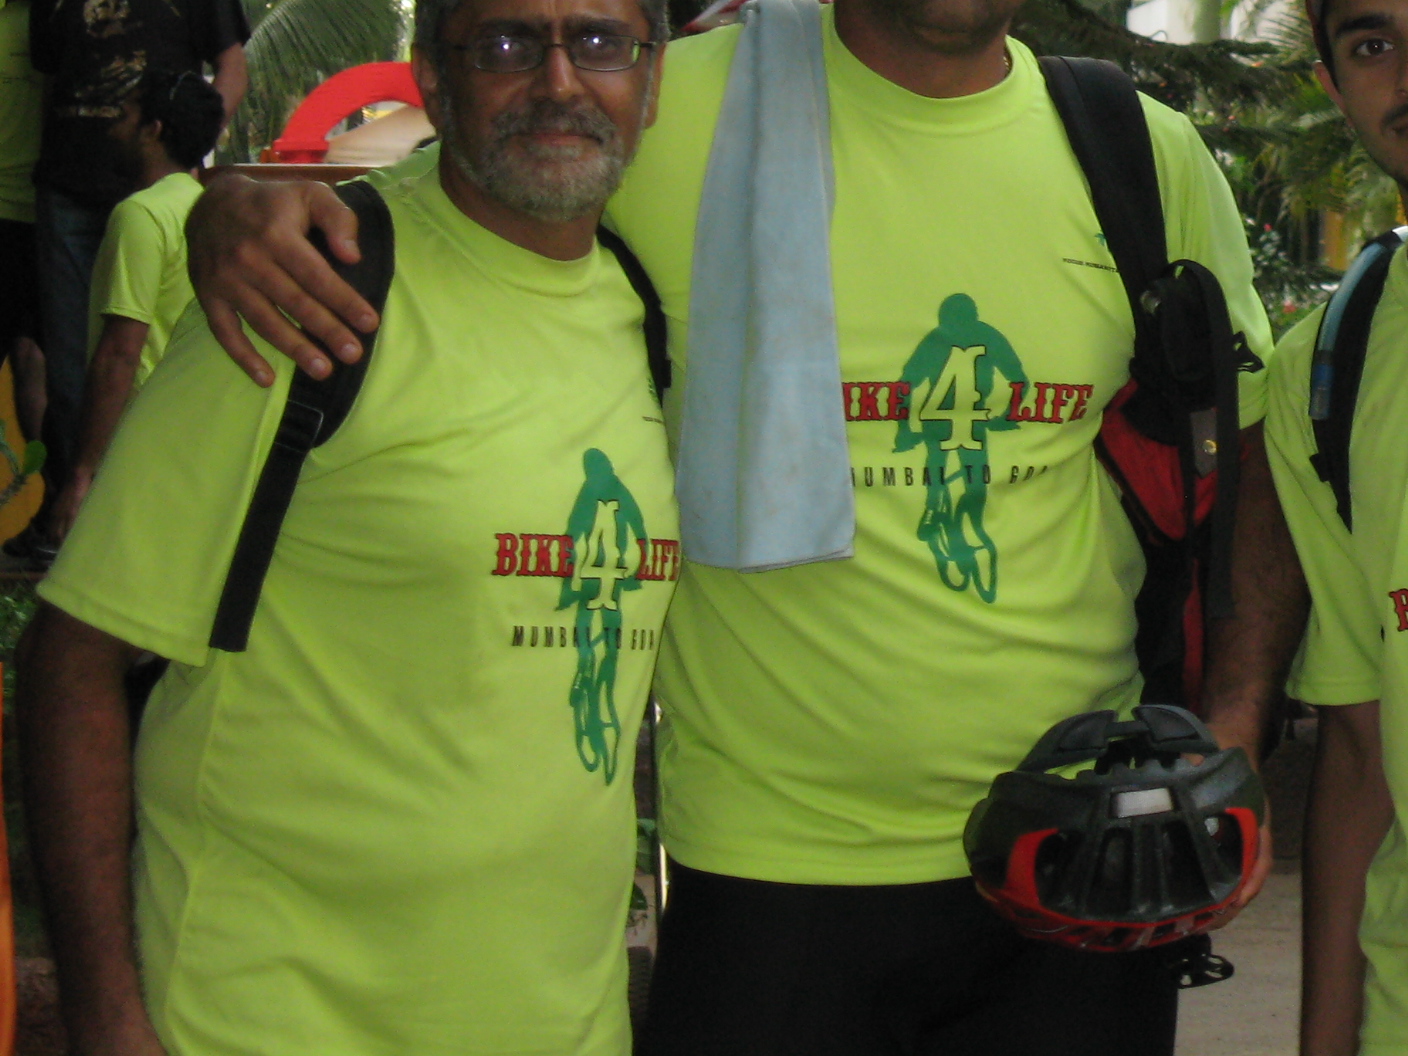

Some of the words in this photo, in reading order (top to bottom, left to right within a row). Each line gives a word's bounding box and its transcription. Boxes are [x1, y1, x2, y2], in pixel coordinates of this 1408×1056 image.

[842, 381, 911, 421] IKE
[919, 344, 992, 450] 4
[1006, 381, 1094, 424] LIFE
[491, 532, 575, 578] BIKE
[580, 499, 629, 611] 4
